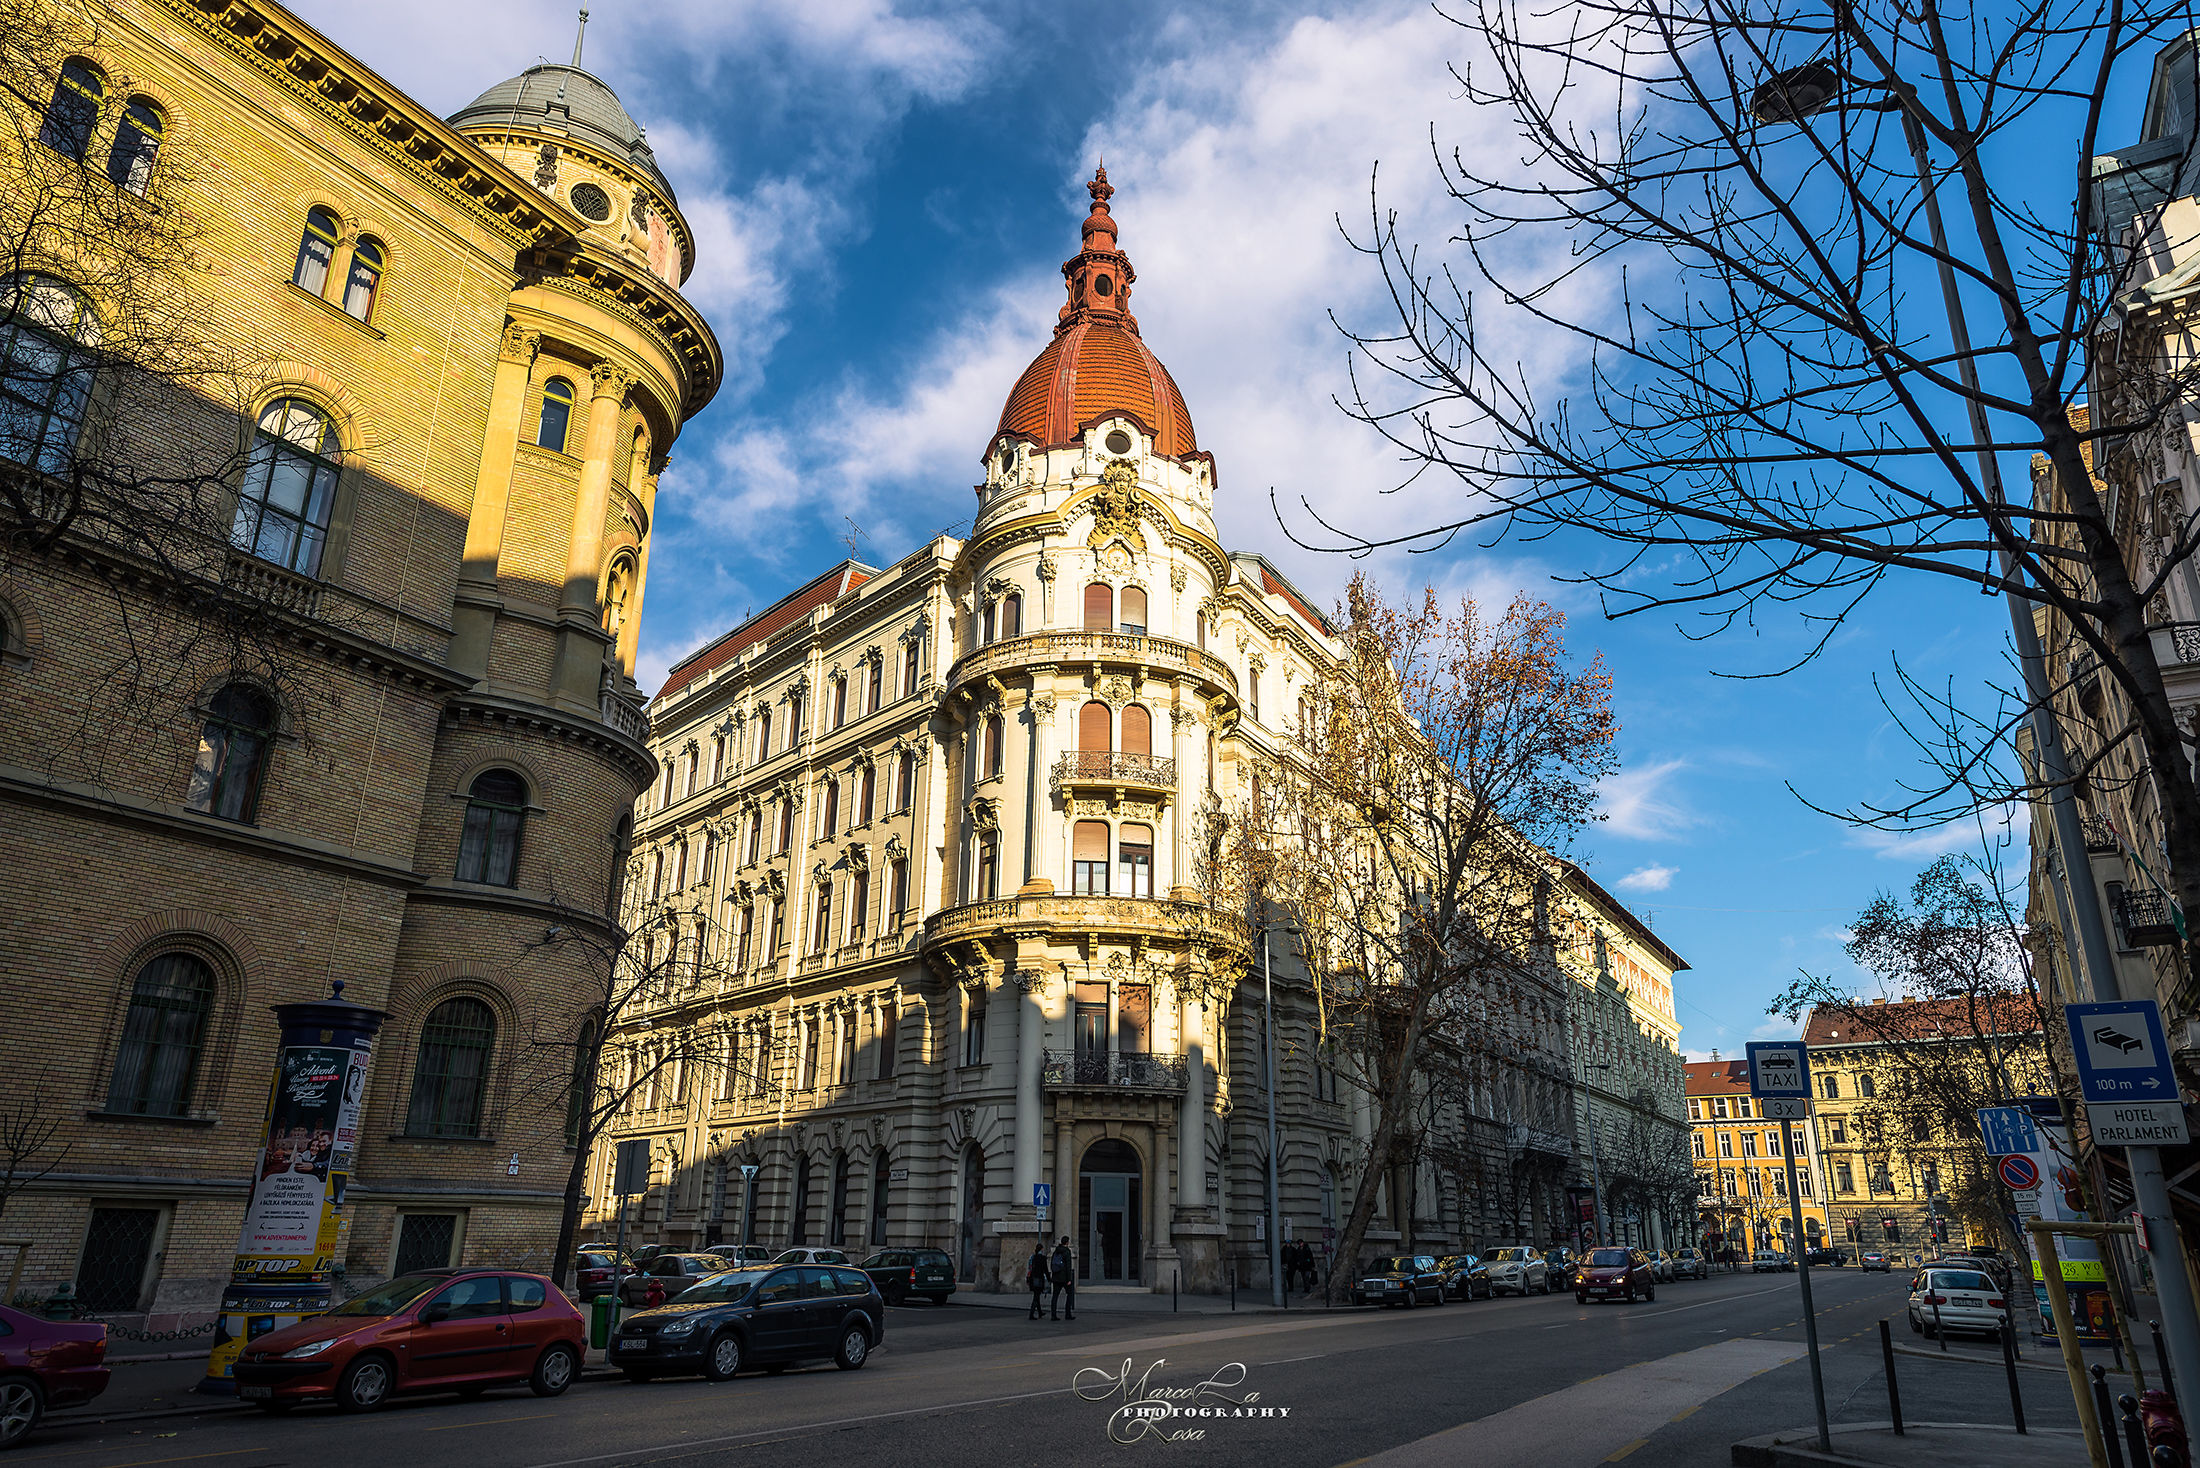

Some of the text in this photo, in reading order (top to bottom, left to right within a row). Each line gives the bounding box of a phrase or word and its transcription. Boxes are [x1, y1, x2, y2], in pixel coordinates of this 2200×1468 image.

[1762, 1073, 1798, 1087] TAXI
[2095, 1079, 2133, 1091] 100 m
[2114, 1109, 2158, 1122] HOTEL
[2019, 1124, 2028, 1134] P
[2100, 1126, 2179, 1140] PARLAMENT
